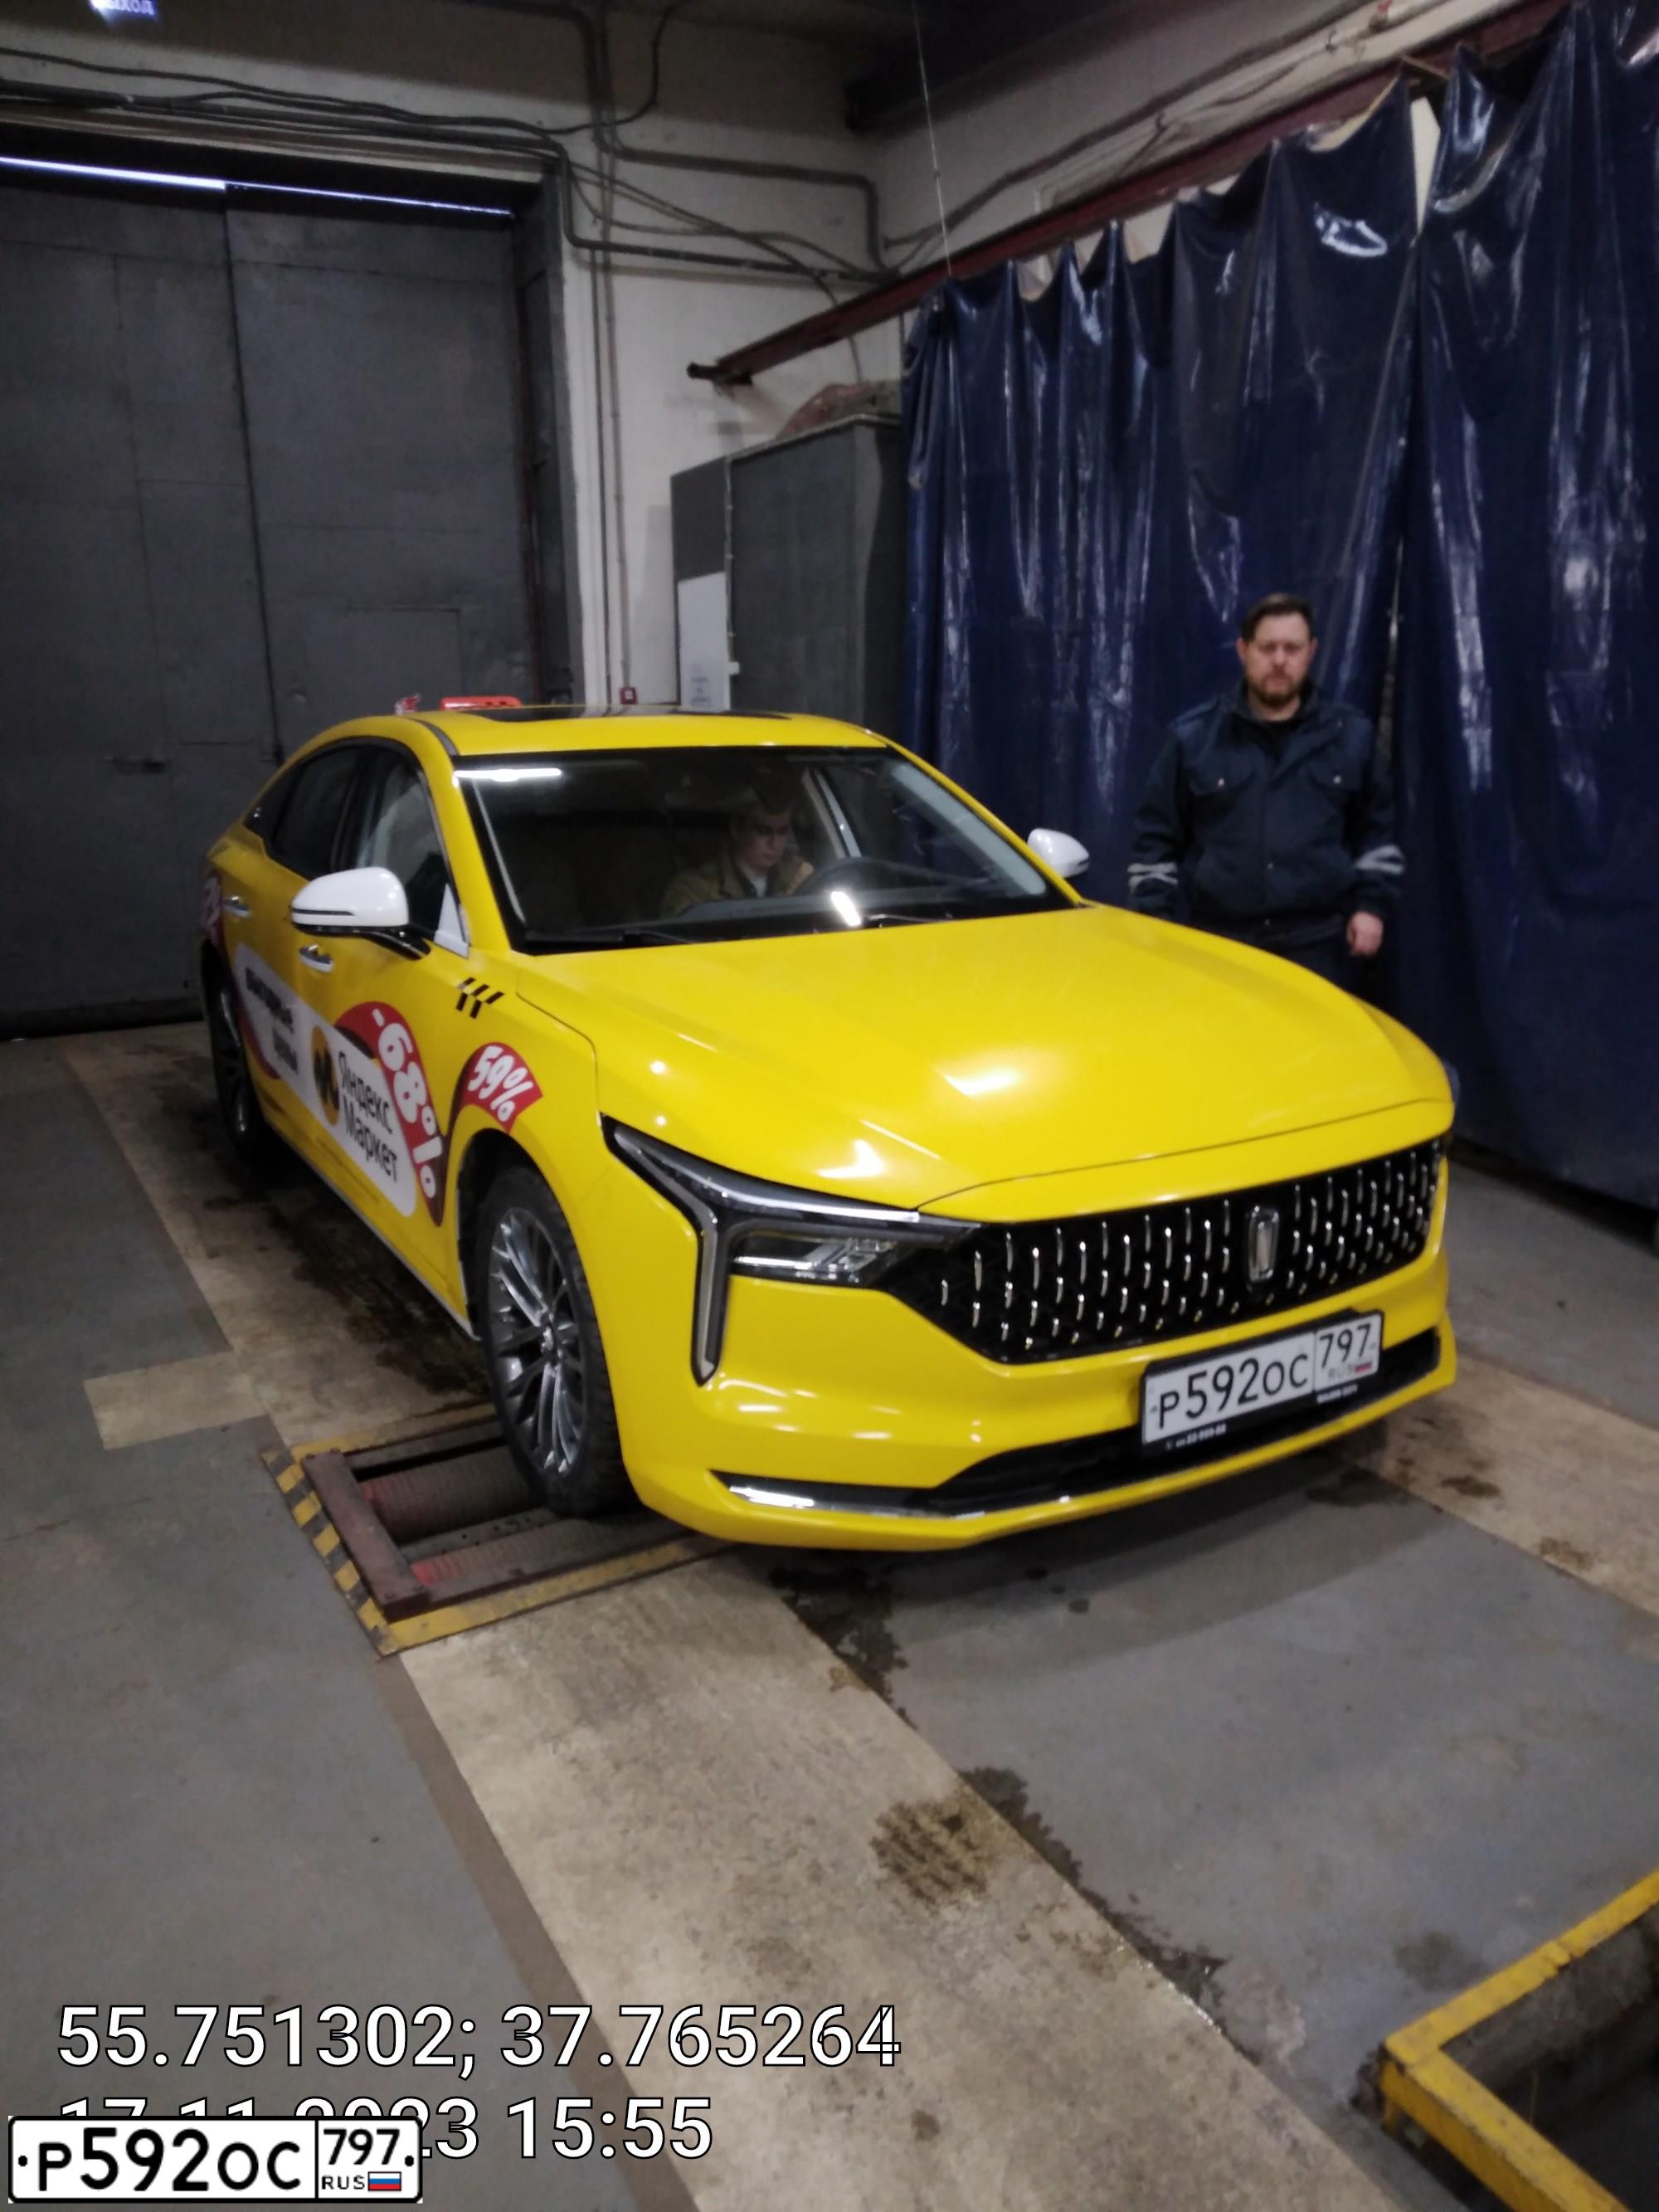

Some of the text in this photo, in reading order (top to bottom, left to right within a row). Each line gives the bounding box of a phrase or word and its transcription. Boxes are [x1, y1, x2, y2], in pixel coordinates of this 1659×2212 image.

[338, 1050, 393, 1135] Яндекс
[468, 1045, 534, 1123] 59%
[343, 1094, 397, 1183] Маркет
[1158, 1323, 1372, 1430] Р592ОС 797
